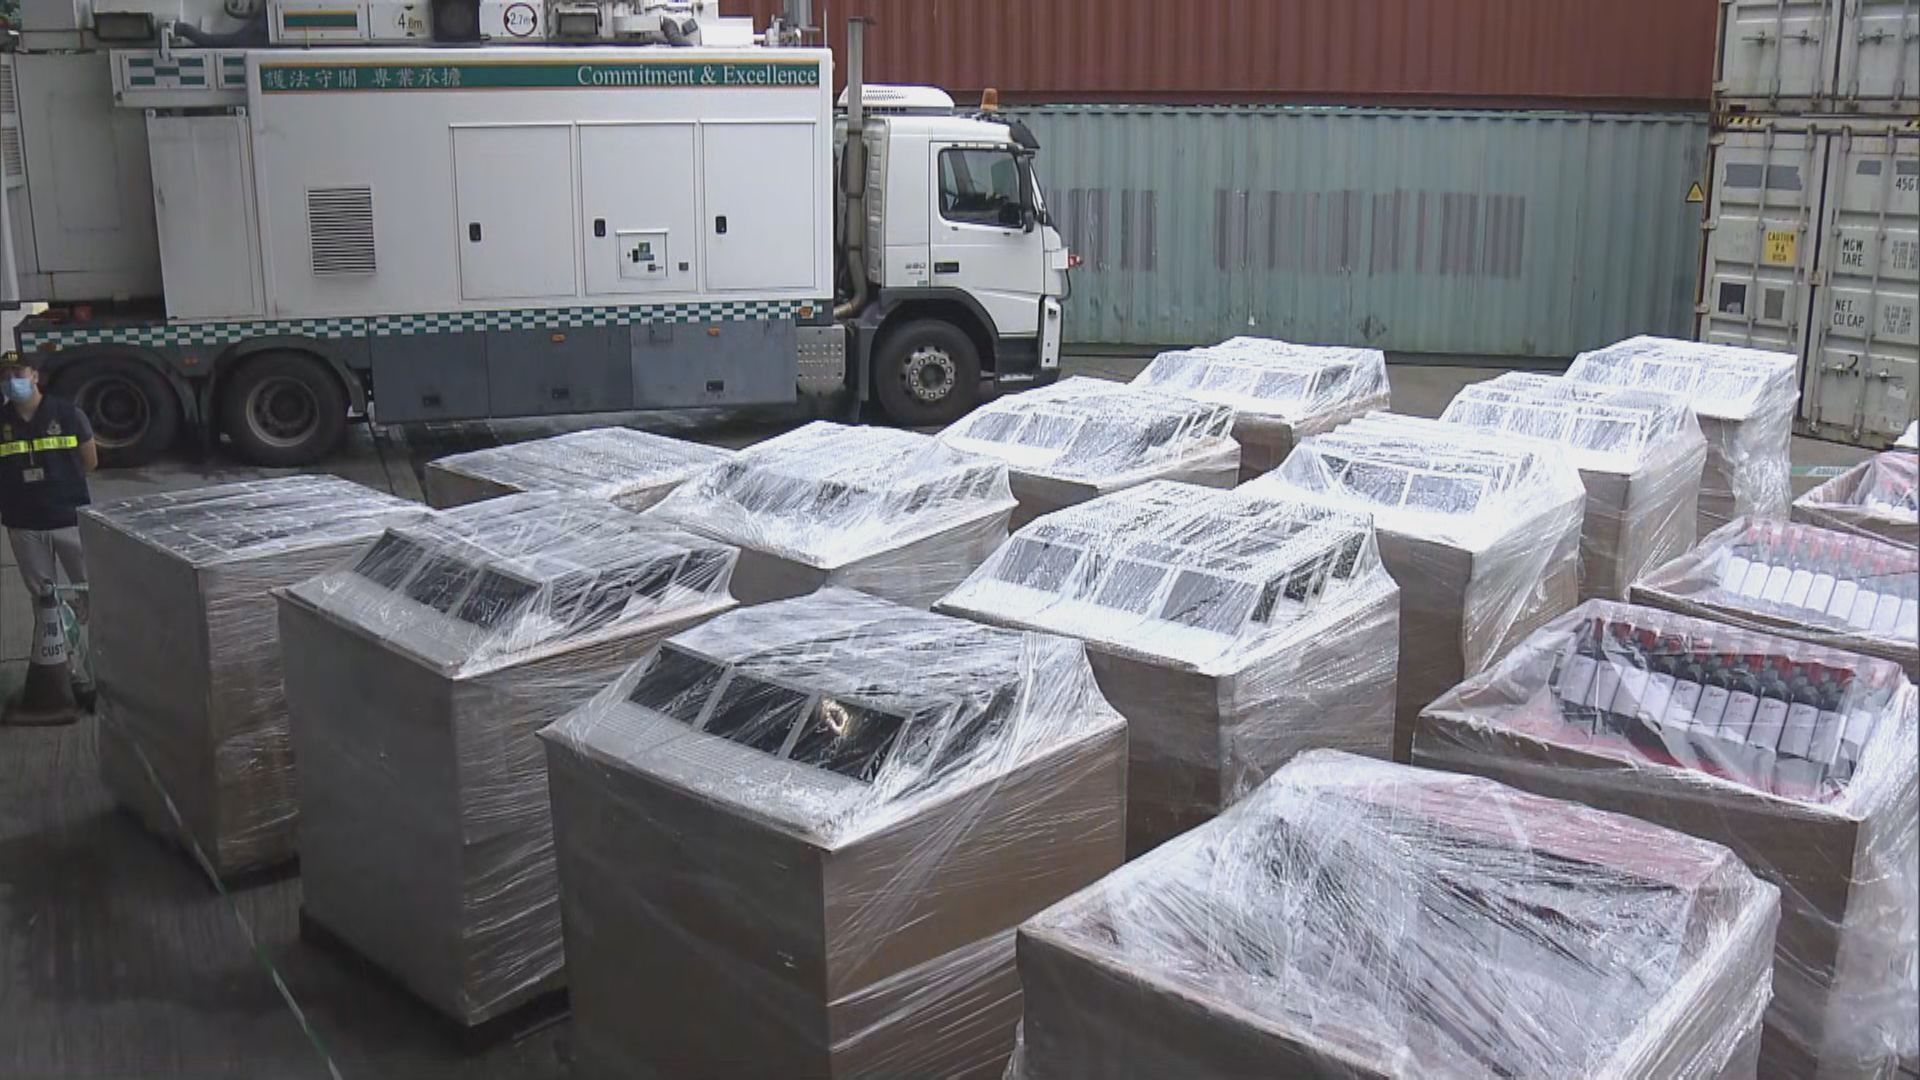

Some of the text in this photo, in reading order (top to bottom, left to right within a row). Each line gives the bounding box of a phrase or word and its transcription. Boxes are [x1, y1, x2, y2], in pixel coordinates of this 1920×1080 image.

[577, 64, 818, 86] Commitment & Excellence
